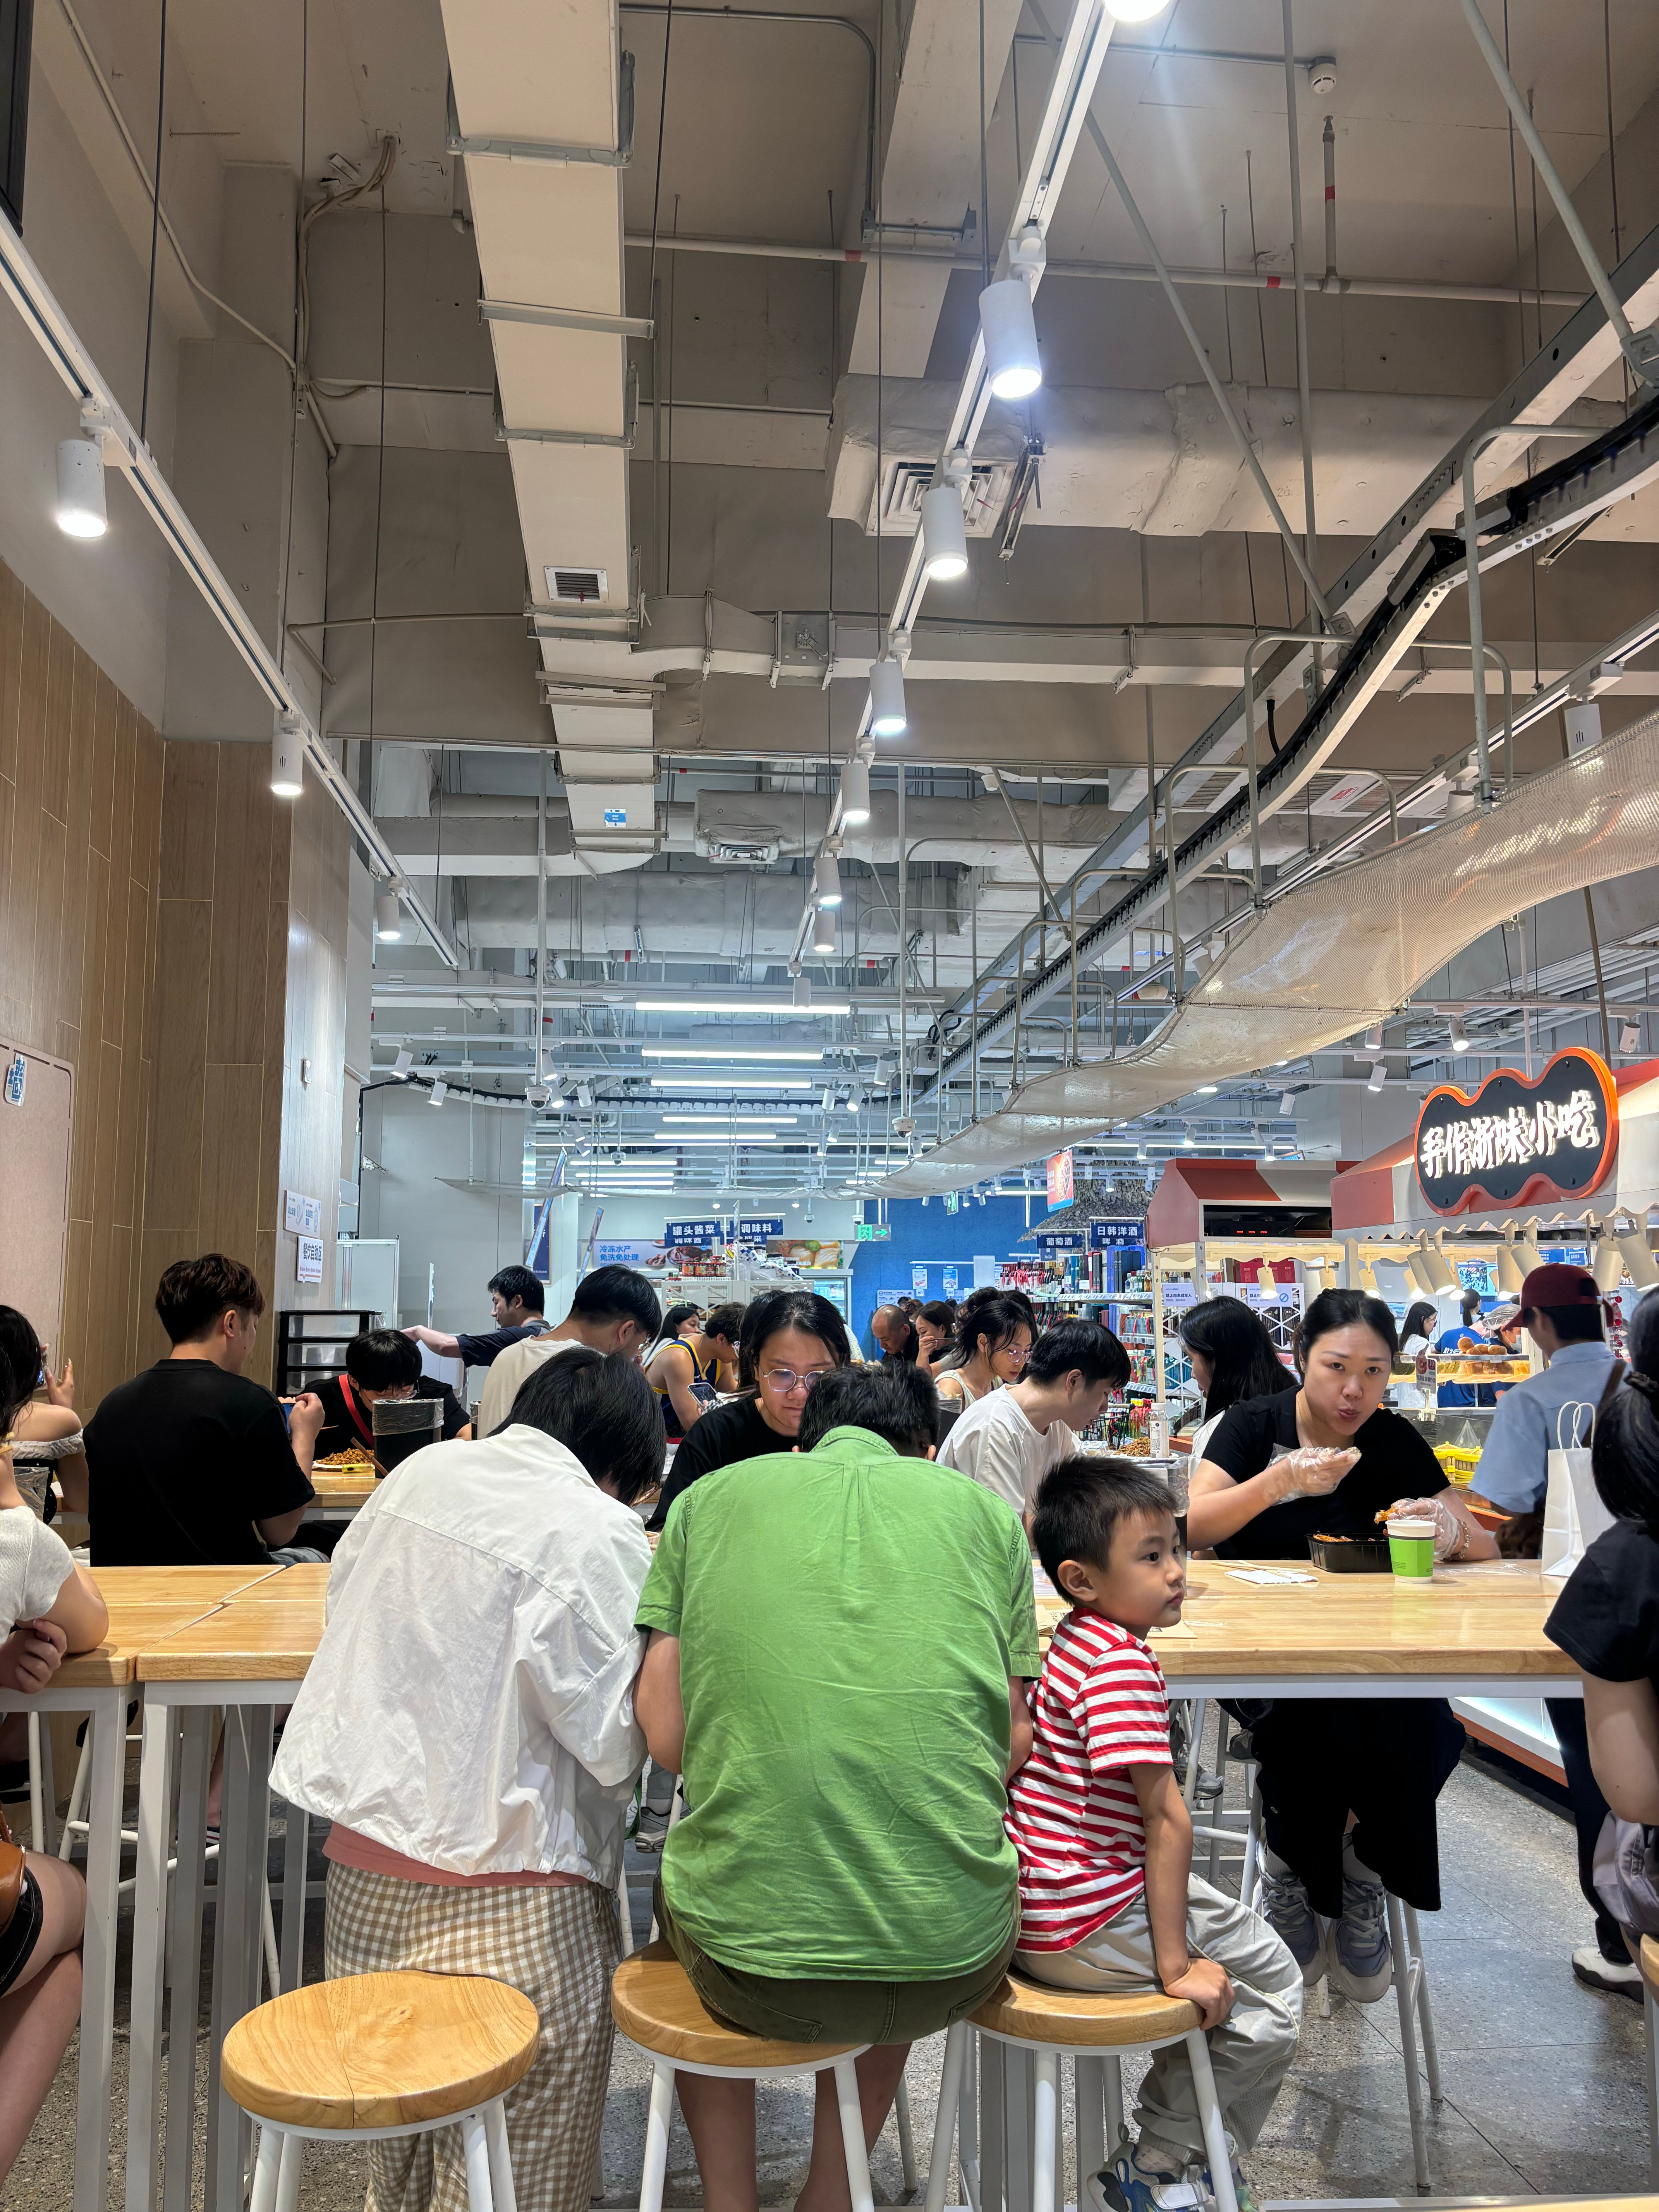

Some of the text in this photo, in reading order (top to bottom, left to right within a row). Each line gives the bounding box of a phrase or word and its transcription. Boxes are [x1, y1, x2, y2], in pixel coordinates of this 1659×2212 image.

[1420, 1089, 1600, 1178] 手作浙味小吃
[672, 1224, 715, 1236] 罐头酱菜
[741, 1223, 772, 1233] 调味料
[1097, 1226, 1138, 1236] 日韩洋酒
[1046, 1237, 1073, 1246] 葡萄酒
